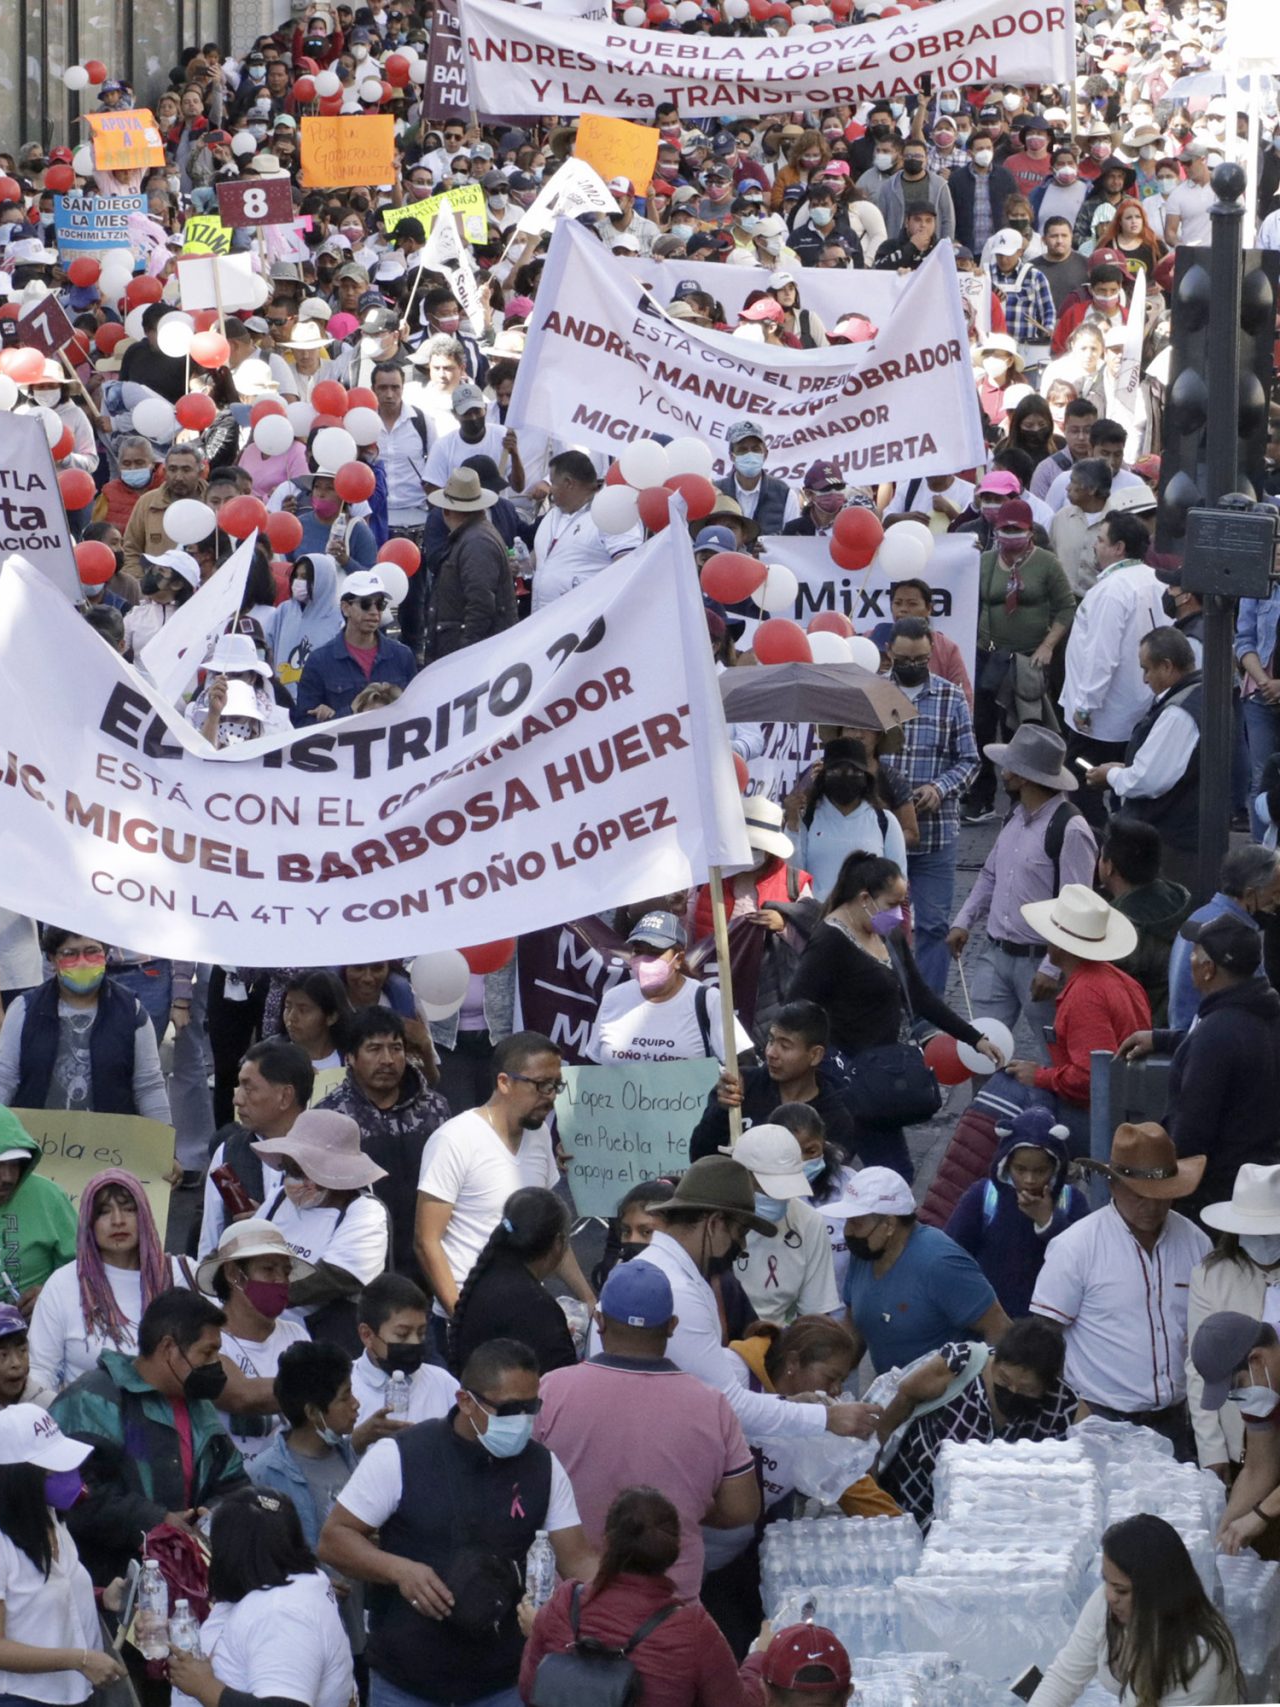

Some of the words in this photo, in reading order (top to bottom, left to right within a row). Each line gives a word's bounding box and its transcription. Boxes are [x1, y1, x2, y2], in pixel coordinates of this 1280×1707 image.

[467, 37, 596, 72] ANDRES
[608, 59, 754, 82] MANUEL
[766, 50, 879, 82] LÓPEZ
[889, 7, 1066, 63] OBRADOR
[606, 35, 745, 60] PUEBLA
[755, 33, 876, 60] APOYA
[886, 22, 918, 41] A:
[530, 78, 552, 103] Y
[563, 82, 605, 105] LA
[614, 87, 655, 108] 4a
[61, 197, 93, 212] SAN
[97, 198, 142, 211] DIEGO
[72, 215, 89, 227] LA
[95, 215, 129, 227] MES
[243, 188, 268, 219] 8
[31, 311, 54, 346] 7
[652, 360, 777, 416] MANUEL
[841, 340, 963, 397] OBRADOR
[701, 349, 755, 377] CON
[762, 370, 792, 390] EL
[639, 385, 652, 405] Y
[656, 396, 703, 431] CON
[96, 753, 193, 812] ESTÁ
[204, 792, 301, 827] CON
[318, 796, 365, 827] EL
[65, 789, 265, 879] MIGUEL
[277, 777, 541, 885] BARBOSA
[91, 870, 175, 912] CON
[192, 894, 239, 923] LA
[250, 904, 295, 925] 4T
[306, 906, 331, 925] Y
[342, 889, 429, 923] CON
[435, 851, 546, 907] TOÑO
[551, 797, 677, 870] LÓPEZ
[612, 1049, 641, 1061] TOÑO
[632, 1037, 675, 1048] EQUIPO
[566, 1079, 615, 1116] Lopez
[622, 1080, 705, 1112] Obrador
[93, 1145, 124, 1166] es
[574, 1130, 593, 1148] en
[598, 1125, 652, 1155] Puebla
[666, 1130, 688, 1155] te
[574, 1163, 613, 1188] apoya
[618, 1160, 634, 1182] el
